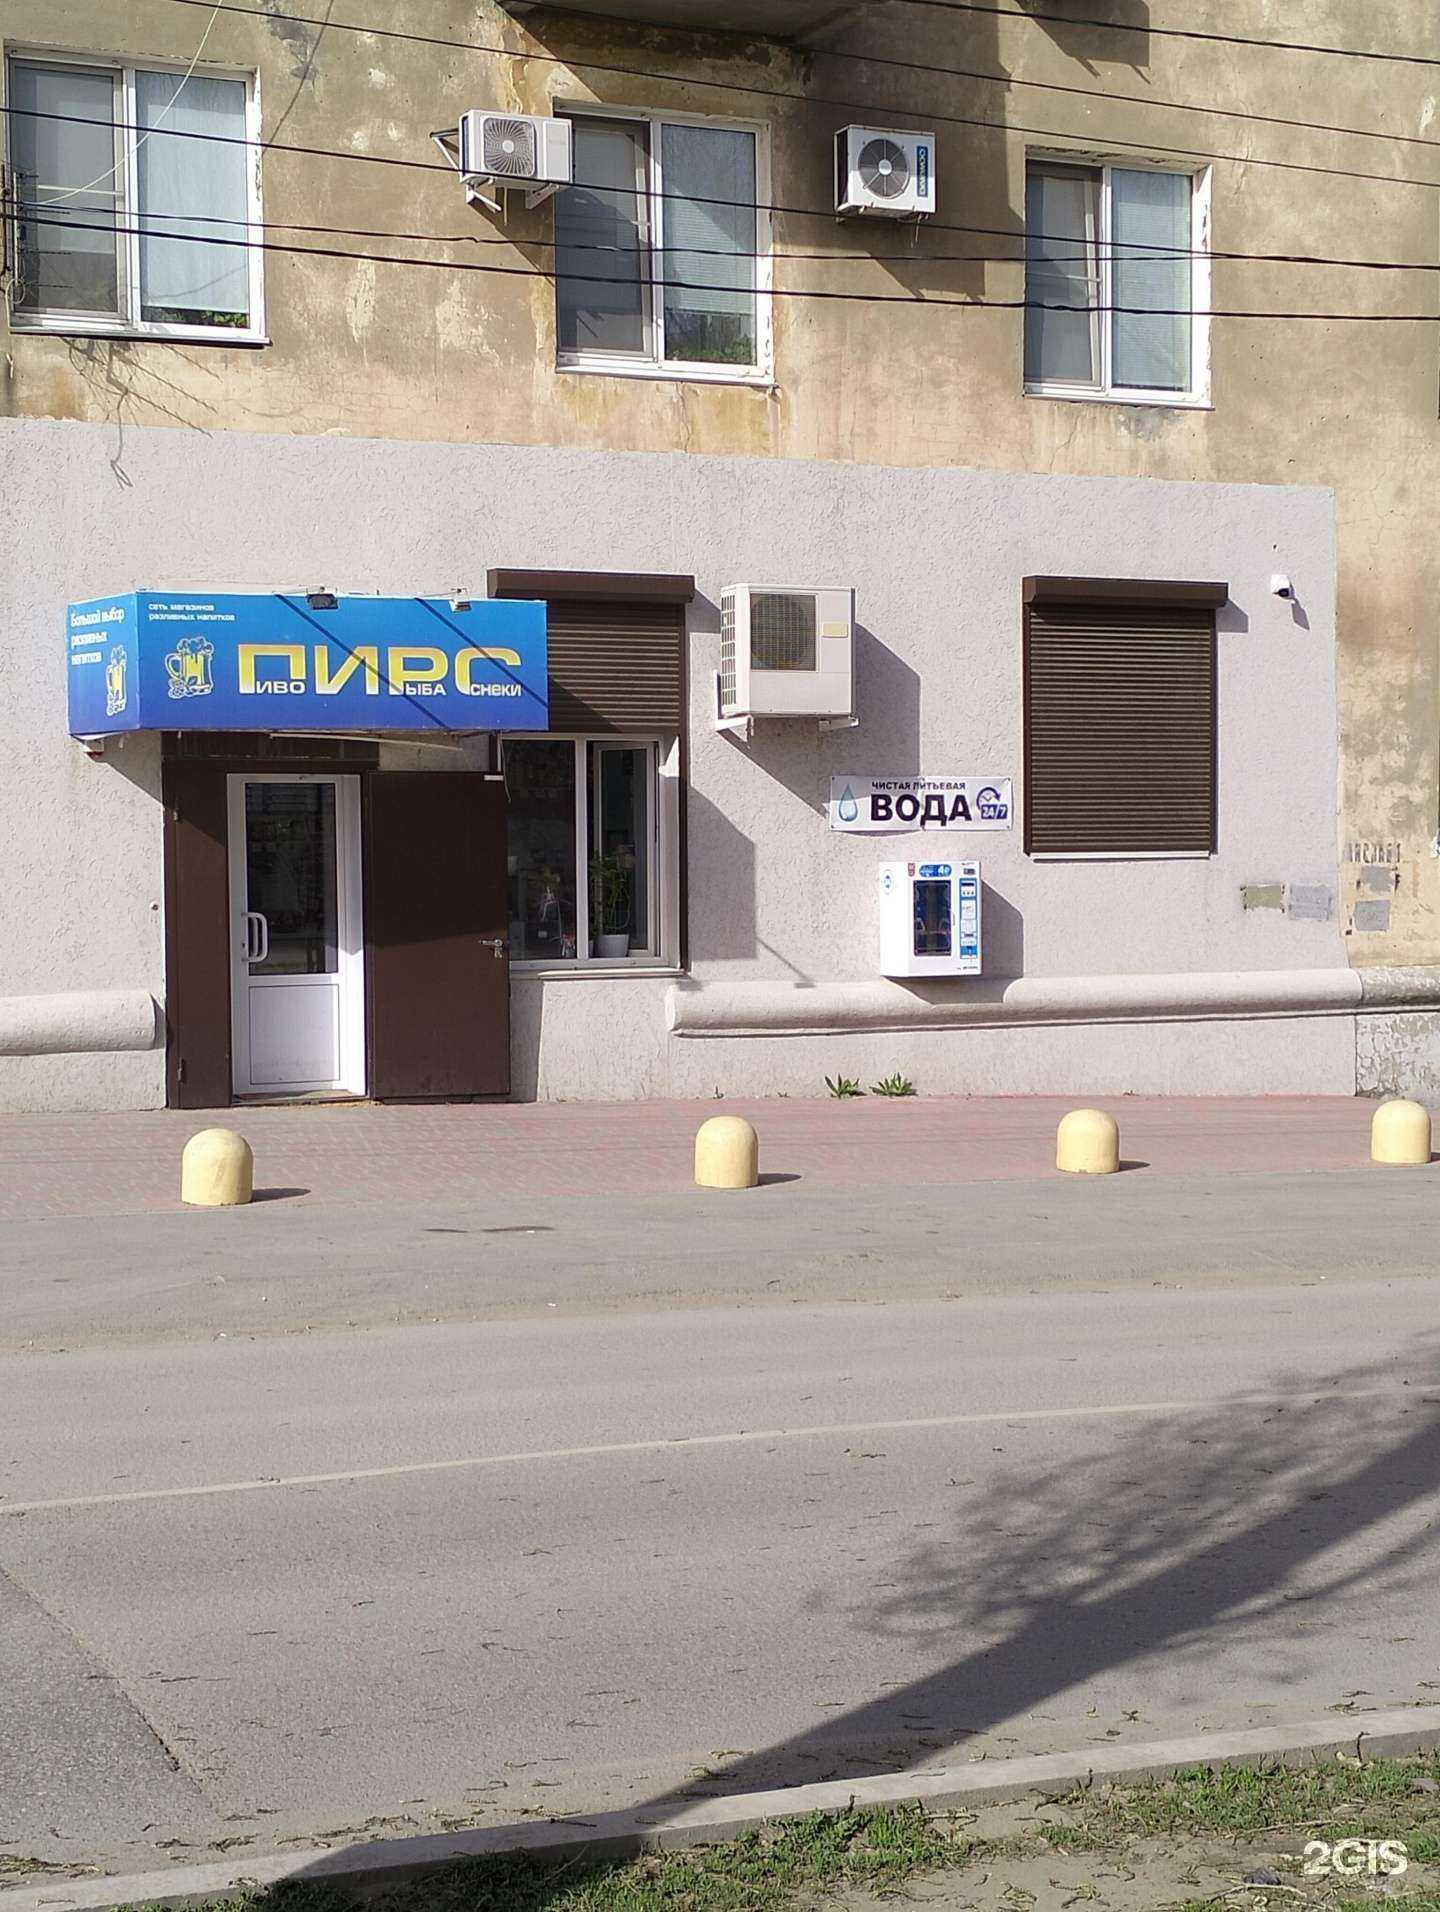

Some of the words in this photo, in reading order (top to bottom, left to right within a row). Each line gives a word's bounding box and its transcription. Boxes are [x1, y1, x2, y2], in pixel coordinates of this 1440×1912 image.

[871, 781, 911, 790] ЧИСТАЯ
[912, 782, 966, 790] ПИТЬЕВАЯ
[870, 793, 973, 827] ВОДА
[981, 804, 1008, 820] 24/7
